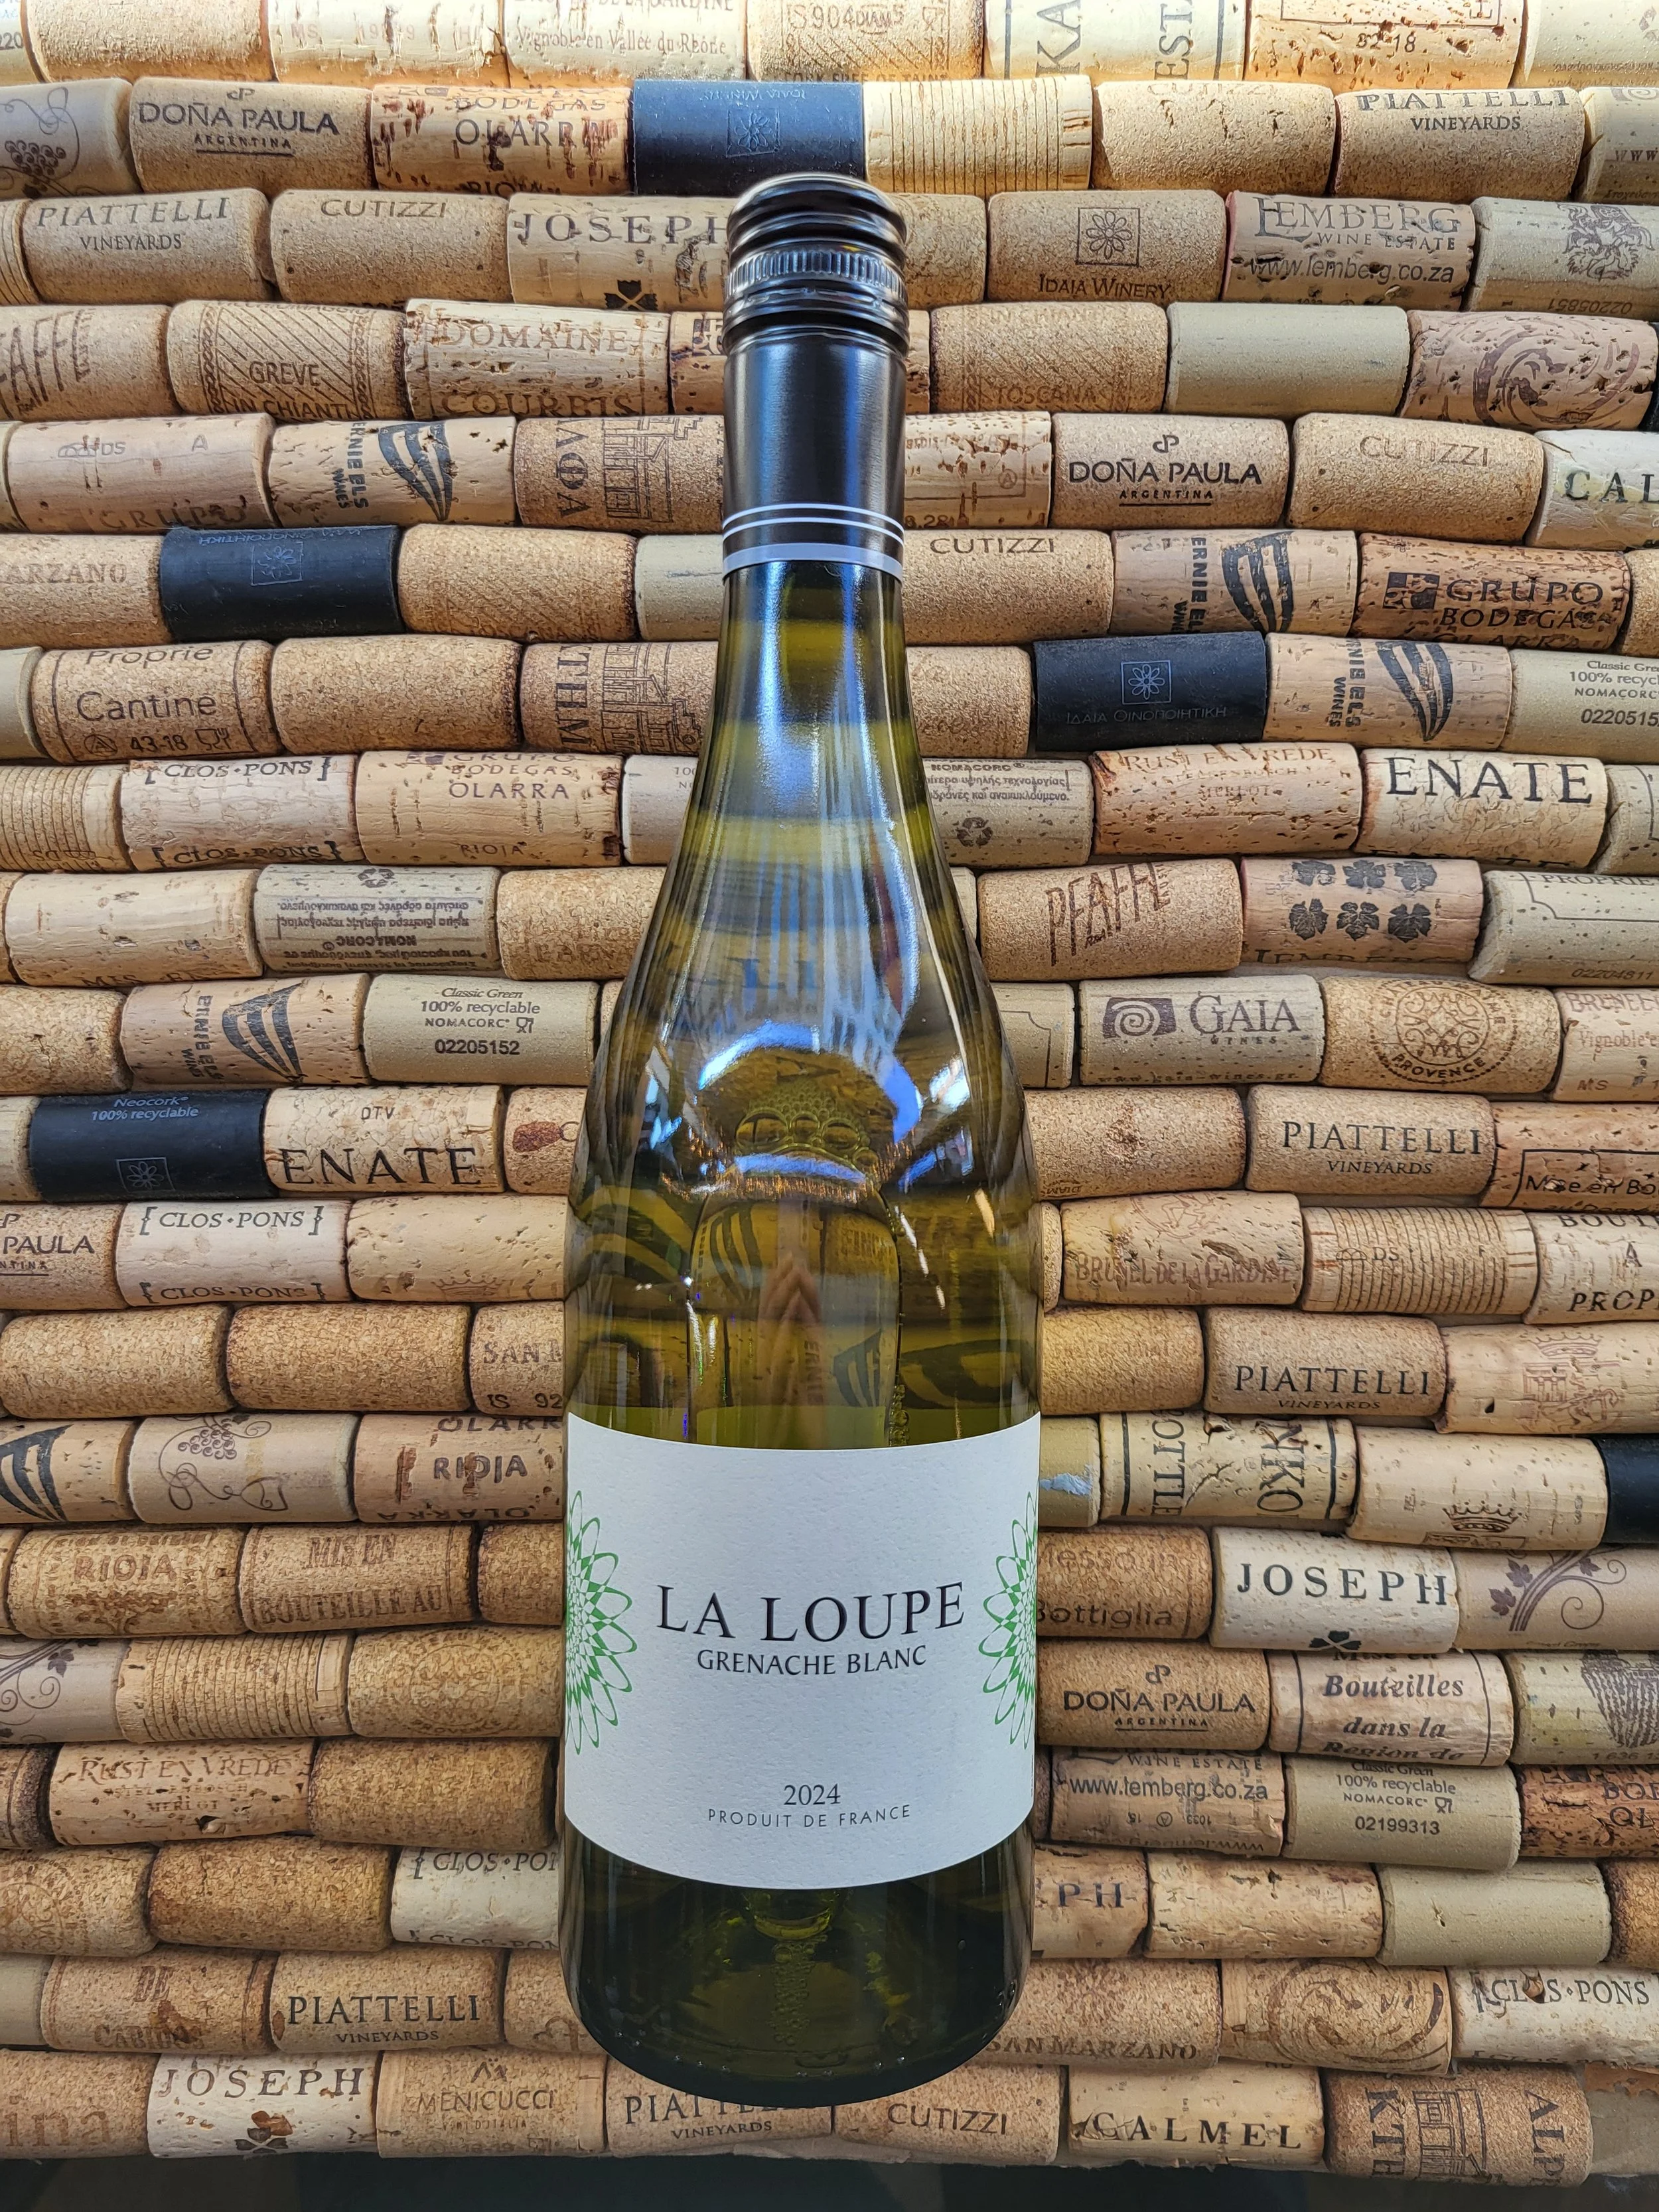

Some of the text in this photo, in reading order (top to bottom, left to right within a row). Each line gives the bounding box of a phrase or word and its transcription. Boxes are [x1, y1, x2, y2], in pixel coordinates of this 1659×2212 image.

[1354, 90, 1571, 113] PIATTELLI
[242, 110, 340, 135] PAULA
[1409, 115, 1521, 131] VINEYARDS
[194, 133, 293, 150] ARGENTINA
[38, 196, 230, 228] PIATTELLI
[321, 198, 447, 218] CUTIZZI
[1253, 196, 1460, 243] LEMBERG
[79, 232, 184, 252] VINEYARDS
[250, 362, 320, 386] GREVE
[1358, 435, 1490, 468] CUTIZZI
[1068, 458, 1262, 484] DOÑA PAULA
[1119, 488, 1214, 500] ARGENTINA
[929, 538, 1054, 555] CUTIZZI
[7, 562, 127, 585] ARZANO
[1445, 579, 1605, 605] GRUPO
[86, 646, 214, 668] Proprie
[1587, 660, 1630, 672] Classic
[1570, 672, 1612, 684] 100%
[76, 690, 218, 721] Cantine
[449, 782, 571, 800] OLARRA
[1385, 757, 1593, 804] ENATE
[441, 987, 523, 1000] Classic Green
[420, 1000, 541, 1016] 100% recyclable
[1189, 990, 1302, 1035] GAIA
[434, 1039, 521, 1057] 02205152
[90, 1106, 199, 1122] 100% recyclable
[1281, 1121, 1481, 1155] PIATTELLI
[278, 1147, 488, 1187] ENATE
[1327, 1159, 1433, 1175] VINEYARDS
[3, 1236, 95, 1254] PAULA
[1232, 1365, 1431, 1396] PIATTELLI
[1275, 1398, 1381, 1410] VINEYARDS
[1236, 1562, 1447, 1607] JOSEPH
[658, 1582, 964, 1643] LA LOUPE
[697, 1645, 928, 1675] GRENACHE BLANC
[1322, 1674, 1464, 1698] Bouteilles
[1063, 1688, 1254, 1714] DOÑA PAULA
[1114, 1717, 1208, 1727] ARGENTINA
[1342, 1717, 1447, 1739] dans la
[1351, 1761, 1434, 1777] Classic Green
[783, 1783, 841, 1806] 2024
[1069, 1776, 1269, 1803] www.lemberg.co.za
[1336, 1773, 1457, 1795] 100% recyclable
[707, 1803, 912, 1828] PRODUIT DE FRANCE
[1354, 1816, 1441, 1836] 02199313
[287, 1995, 480, 2025] PIATTELLI
[334, 2028, 439, 2045] VINEYARDS
[158, 2064, 365, 2098] JOSEPH
[671, 2120, 773, 2140] VINEYARDS
[887, 2102, 1007, 2136] CUTIZZI
[1092, 2110, 1302, 2149] CALMEL
